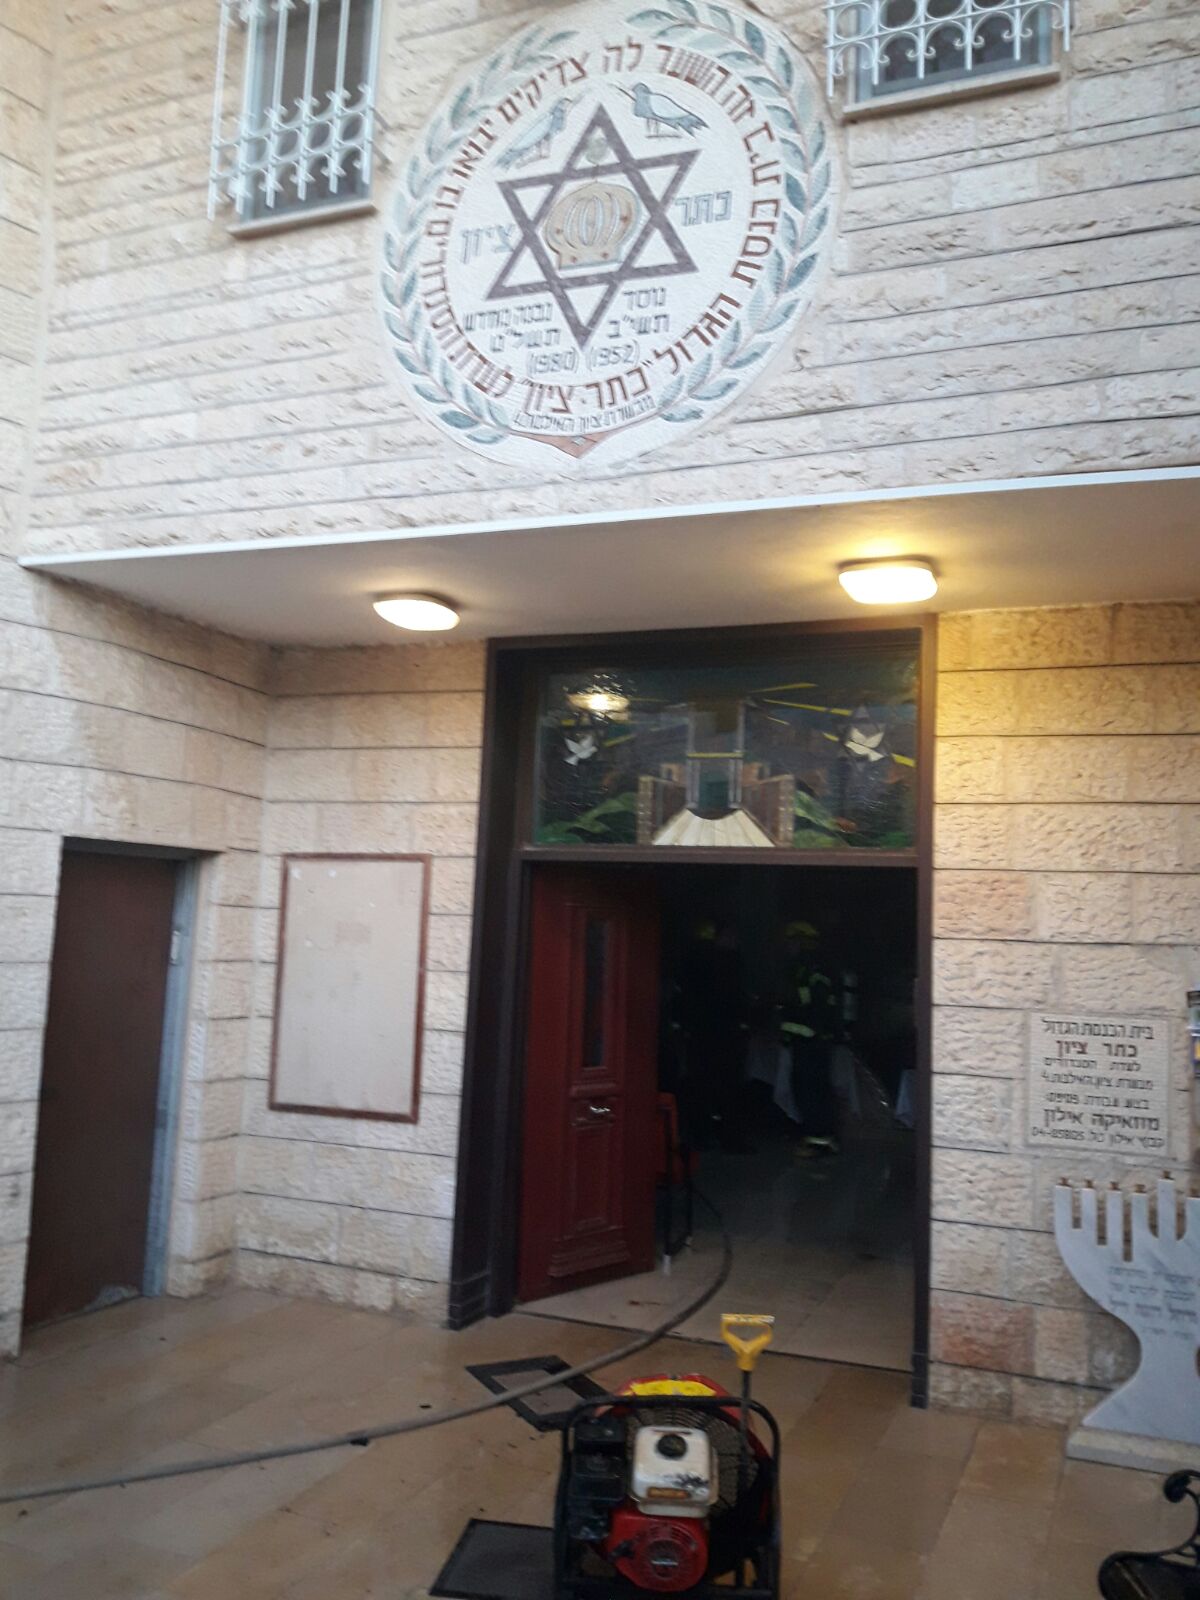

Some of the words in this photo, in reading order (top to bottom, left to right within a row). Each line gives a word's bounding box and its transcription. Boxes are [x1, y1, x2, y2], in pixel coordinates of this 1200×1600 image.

[496, 51, 590, 124] צדיקים
[451, 118, 497, 180] יבואו
[434, 185, 464, 209] בו
[674, 190, 732, 227] כתר
[461, 224, 516, 264] ציון
[731, 199, 780, 290] כנסת
[622, 287, 666, 310] נוסד
[653, 292, 742, 376] הגדול
[1040, 1016, 1079, 1035] הגדול
[1081, 1022, 1126, 1038] הכנסת
[1128, 1025, 1155, 1040] בית
[1056, 1039, 1088, 1058] ציון
[1101, 1041, 1138, 1057] כתר
[1043, 1106, 1084, 1128] אילון
